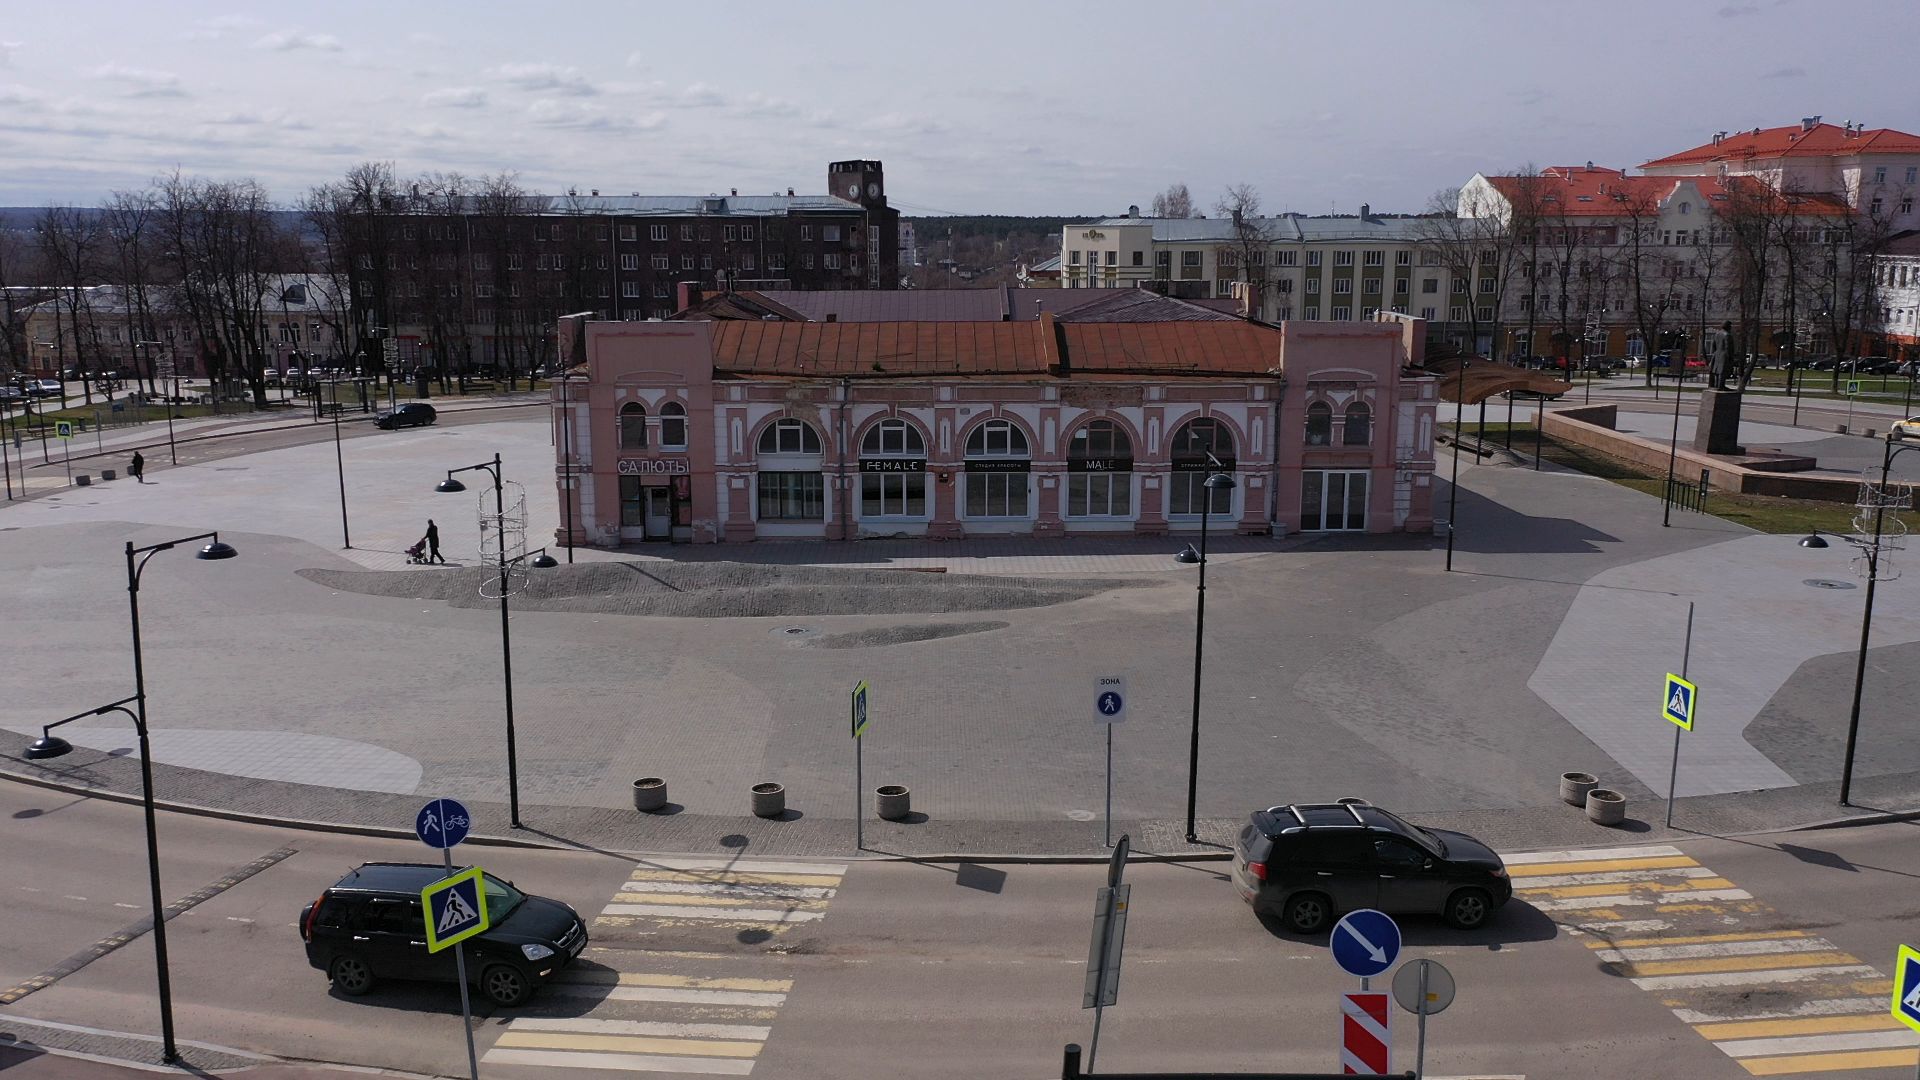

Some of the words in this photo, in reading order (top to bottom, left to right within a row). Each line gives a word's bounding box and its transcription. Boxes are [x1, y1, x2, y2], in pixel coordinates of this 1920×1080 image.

[617, 460, 689, 473] САЛЮТЫ
[866, 461, 918, 470] FEMALE
[1086, 460, 1115, 469] MALE
[1100, 678, 1121, 686] ЗОНА
